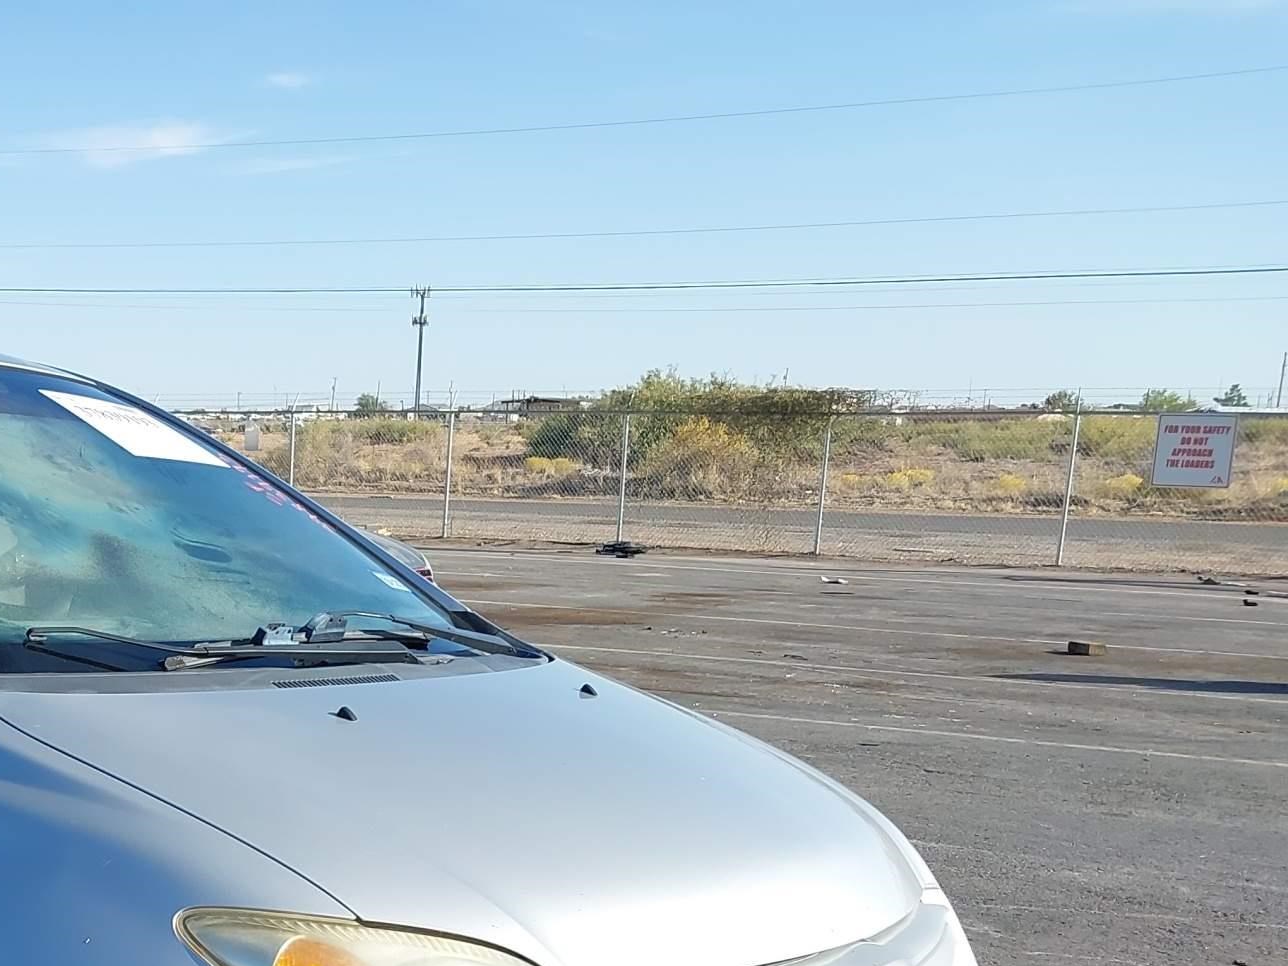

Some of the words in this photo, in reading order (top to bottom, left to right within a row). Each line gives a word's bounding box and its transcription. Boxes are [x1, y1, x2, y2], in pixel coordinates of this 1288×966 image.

[1164, 425, 1179, 433] FOR
[1181, 425, 1202, 434] YOUR
[1203, 426, 1231, 435] SAFETY
[1180, 437, 1192, 445] DO
[1193, 437, 1209, 445] NOT
[1171, 448, 1213, 457] APPROACH
[1166, 459, 1180, 468] THE
[1181, 460, 1215, 469] LOADERS
